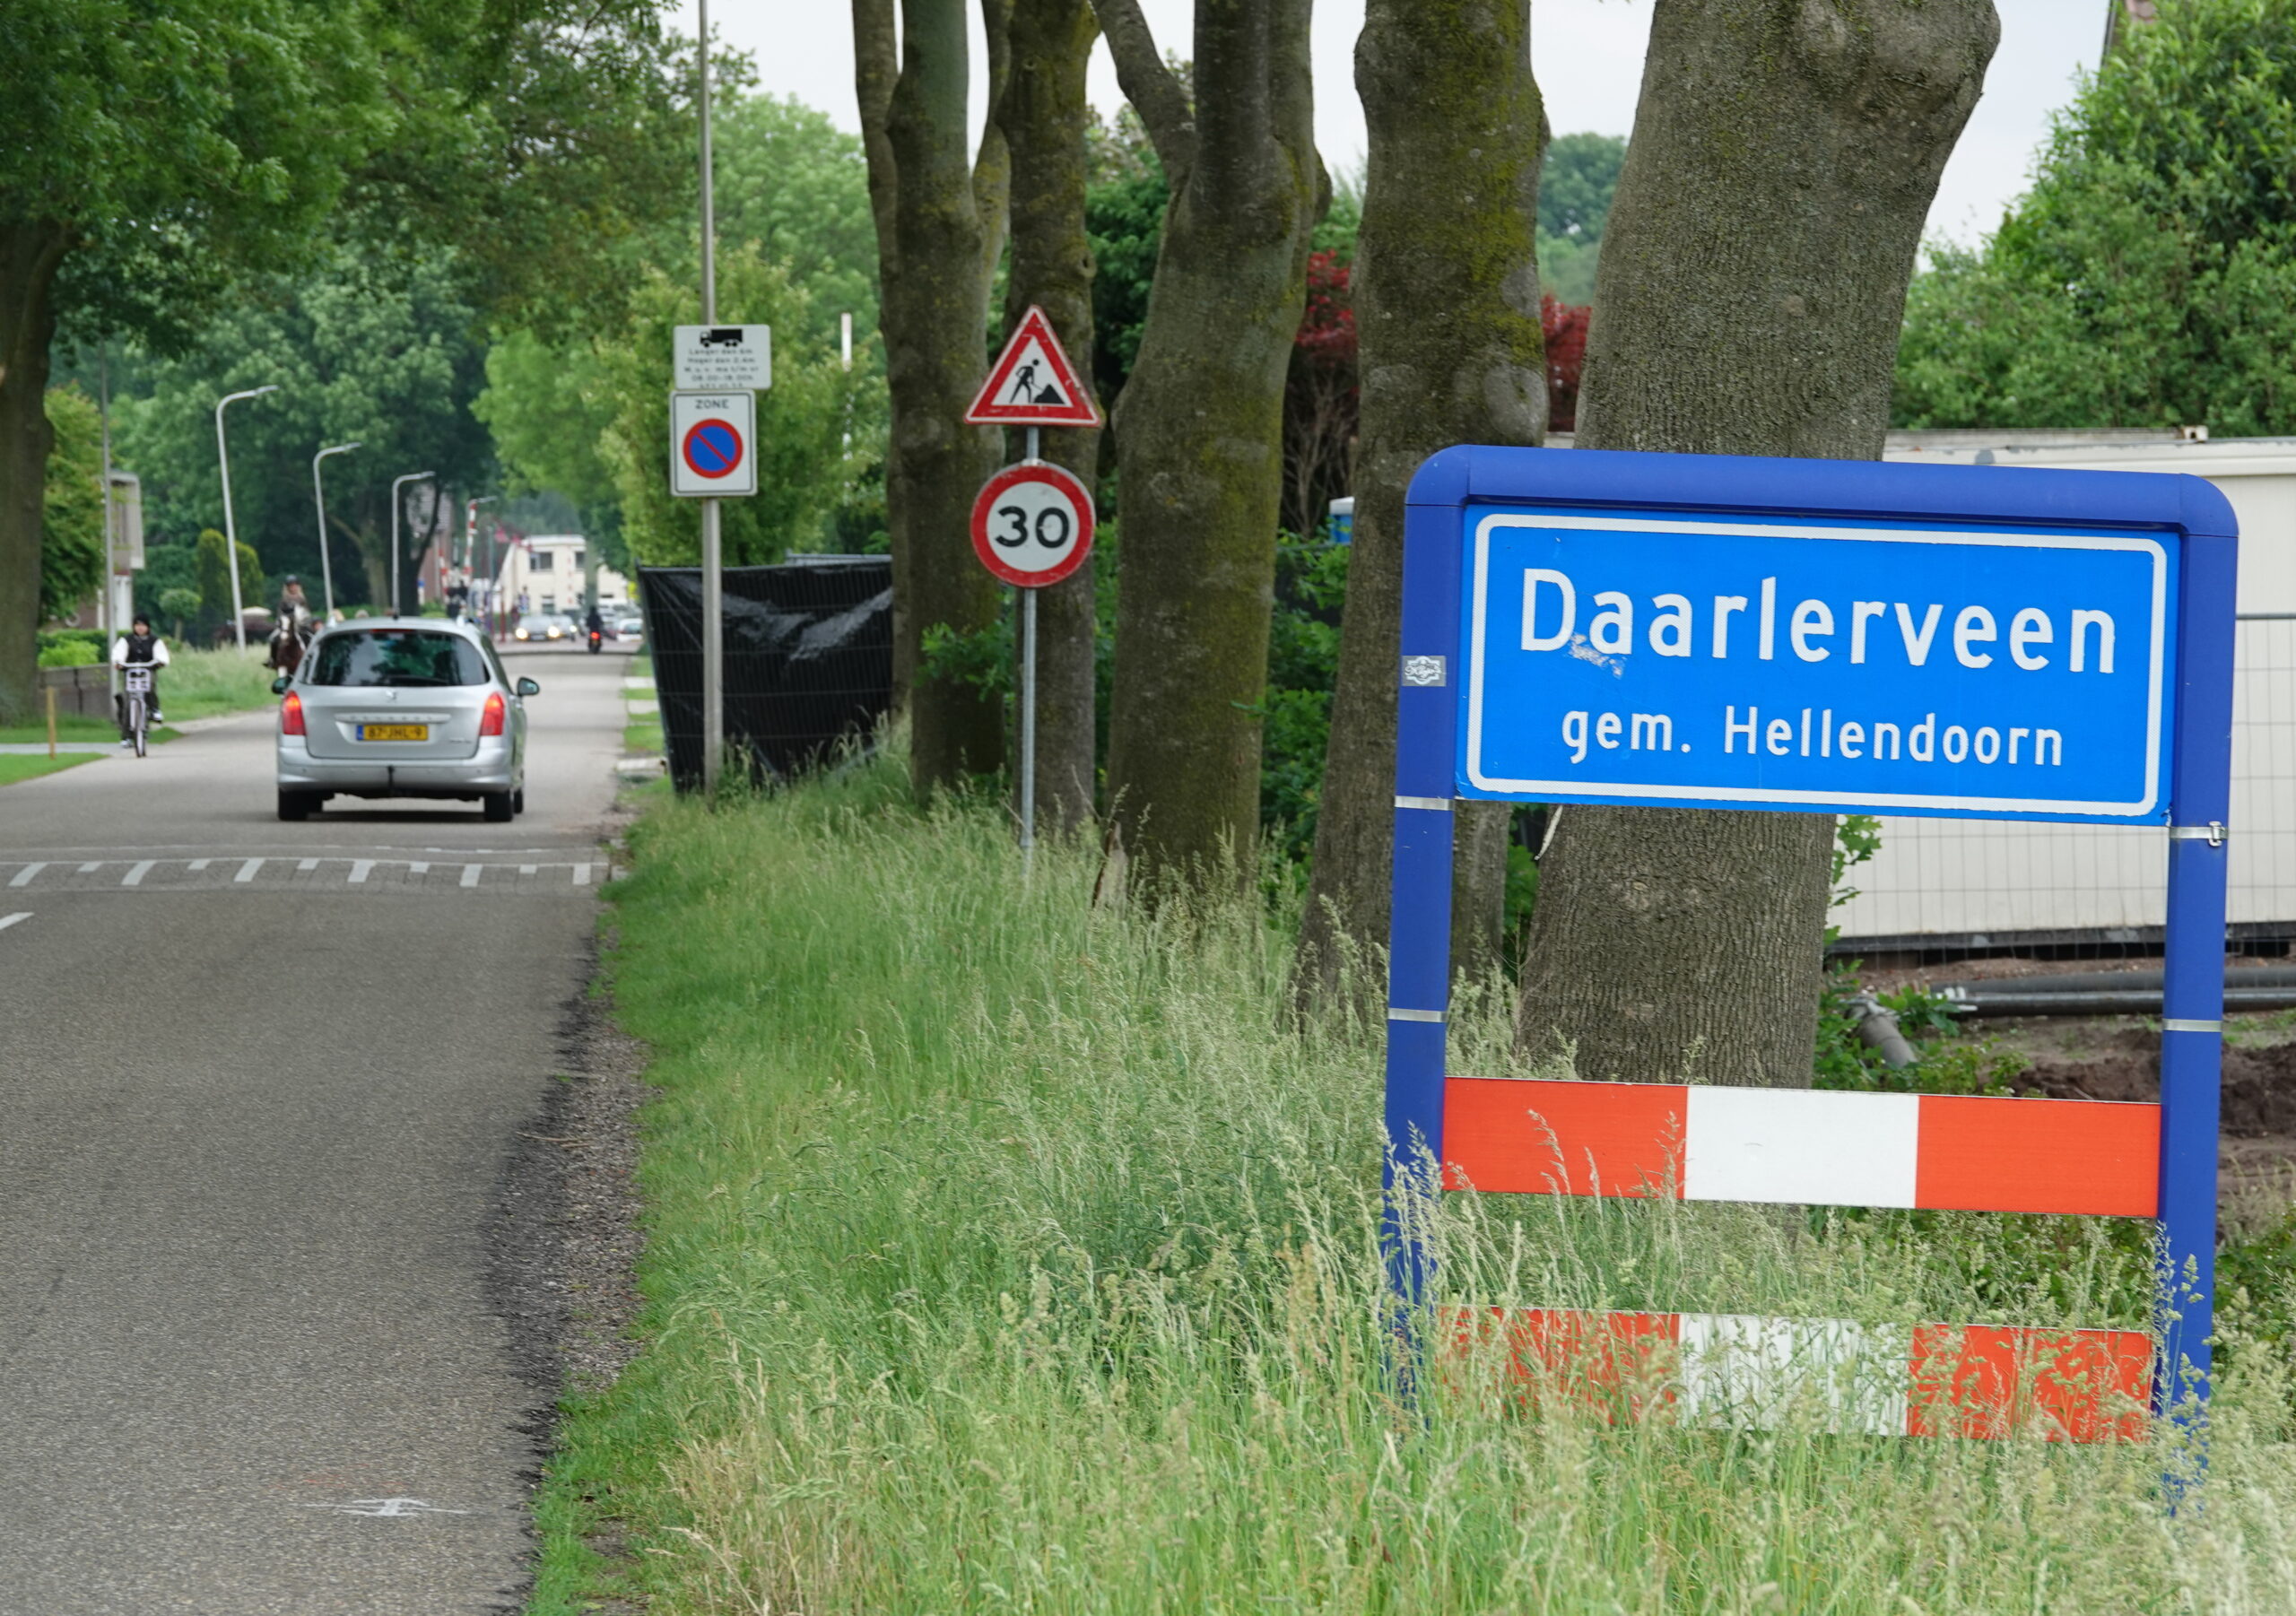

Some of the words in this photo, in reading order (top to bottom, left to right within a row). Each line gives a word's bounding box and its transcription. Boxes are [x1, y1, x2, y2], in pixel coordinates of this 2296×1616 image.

[695, 399, 729, 409] ZONE
[995, 505, 1070, 549] 30
[1521, 568, 2115, 673] Daarlerveen
[1562, 710, 1692, 765] gem.
[1725, 705, 2063, 766] Hellendoorn
